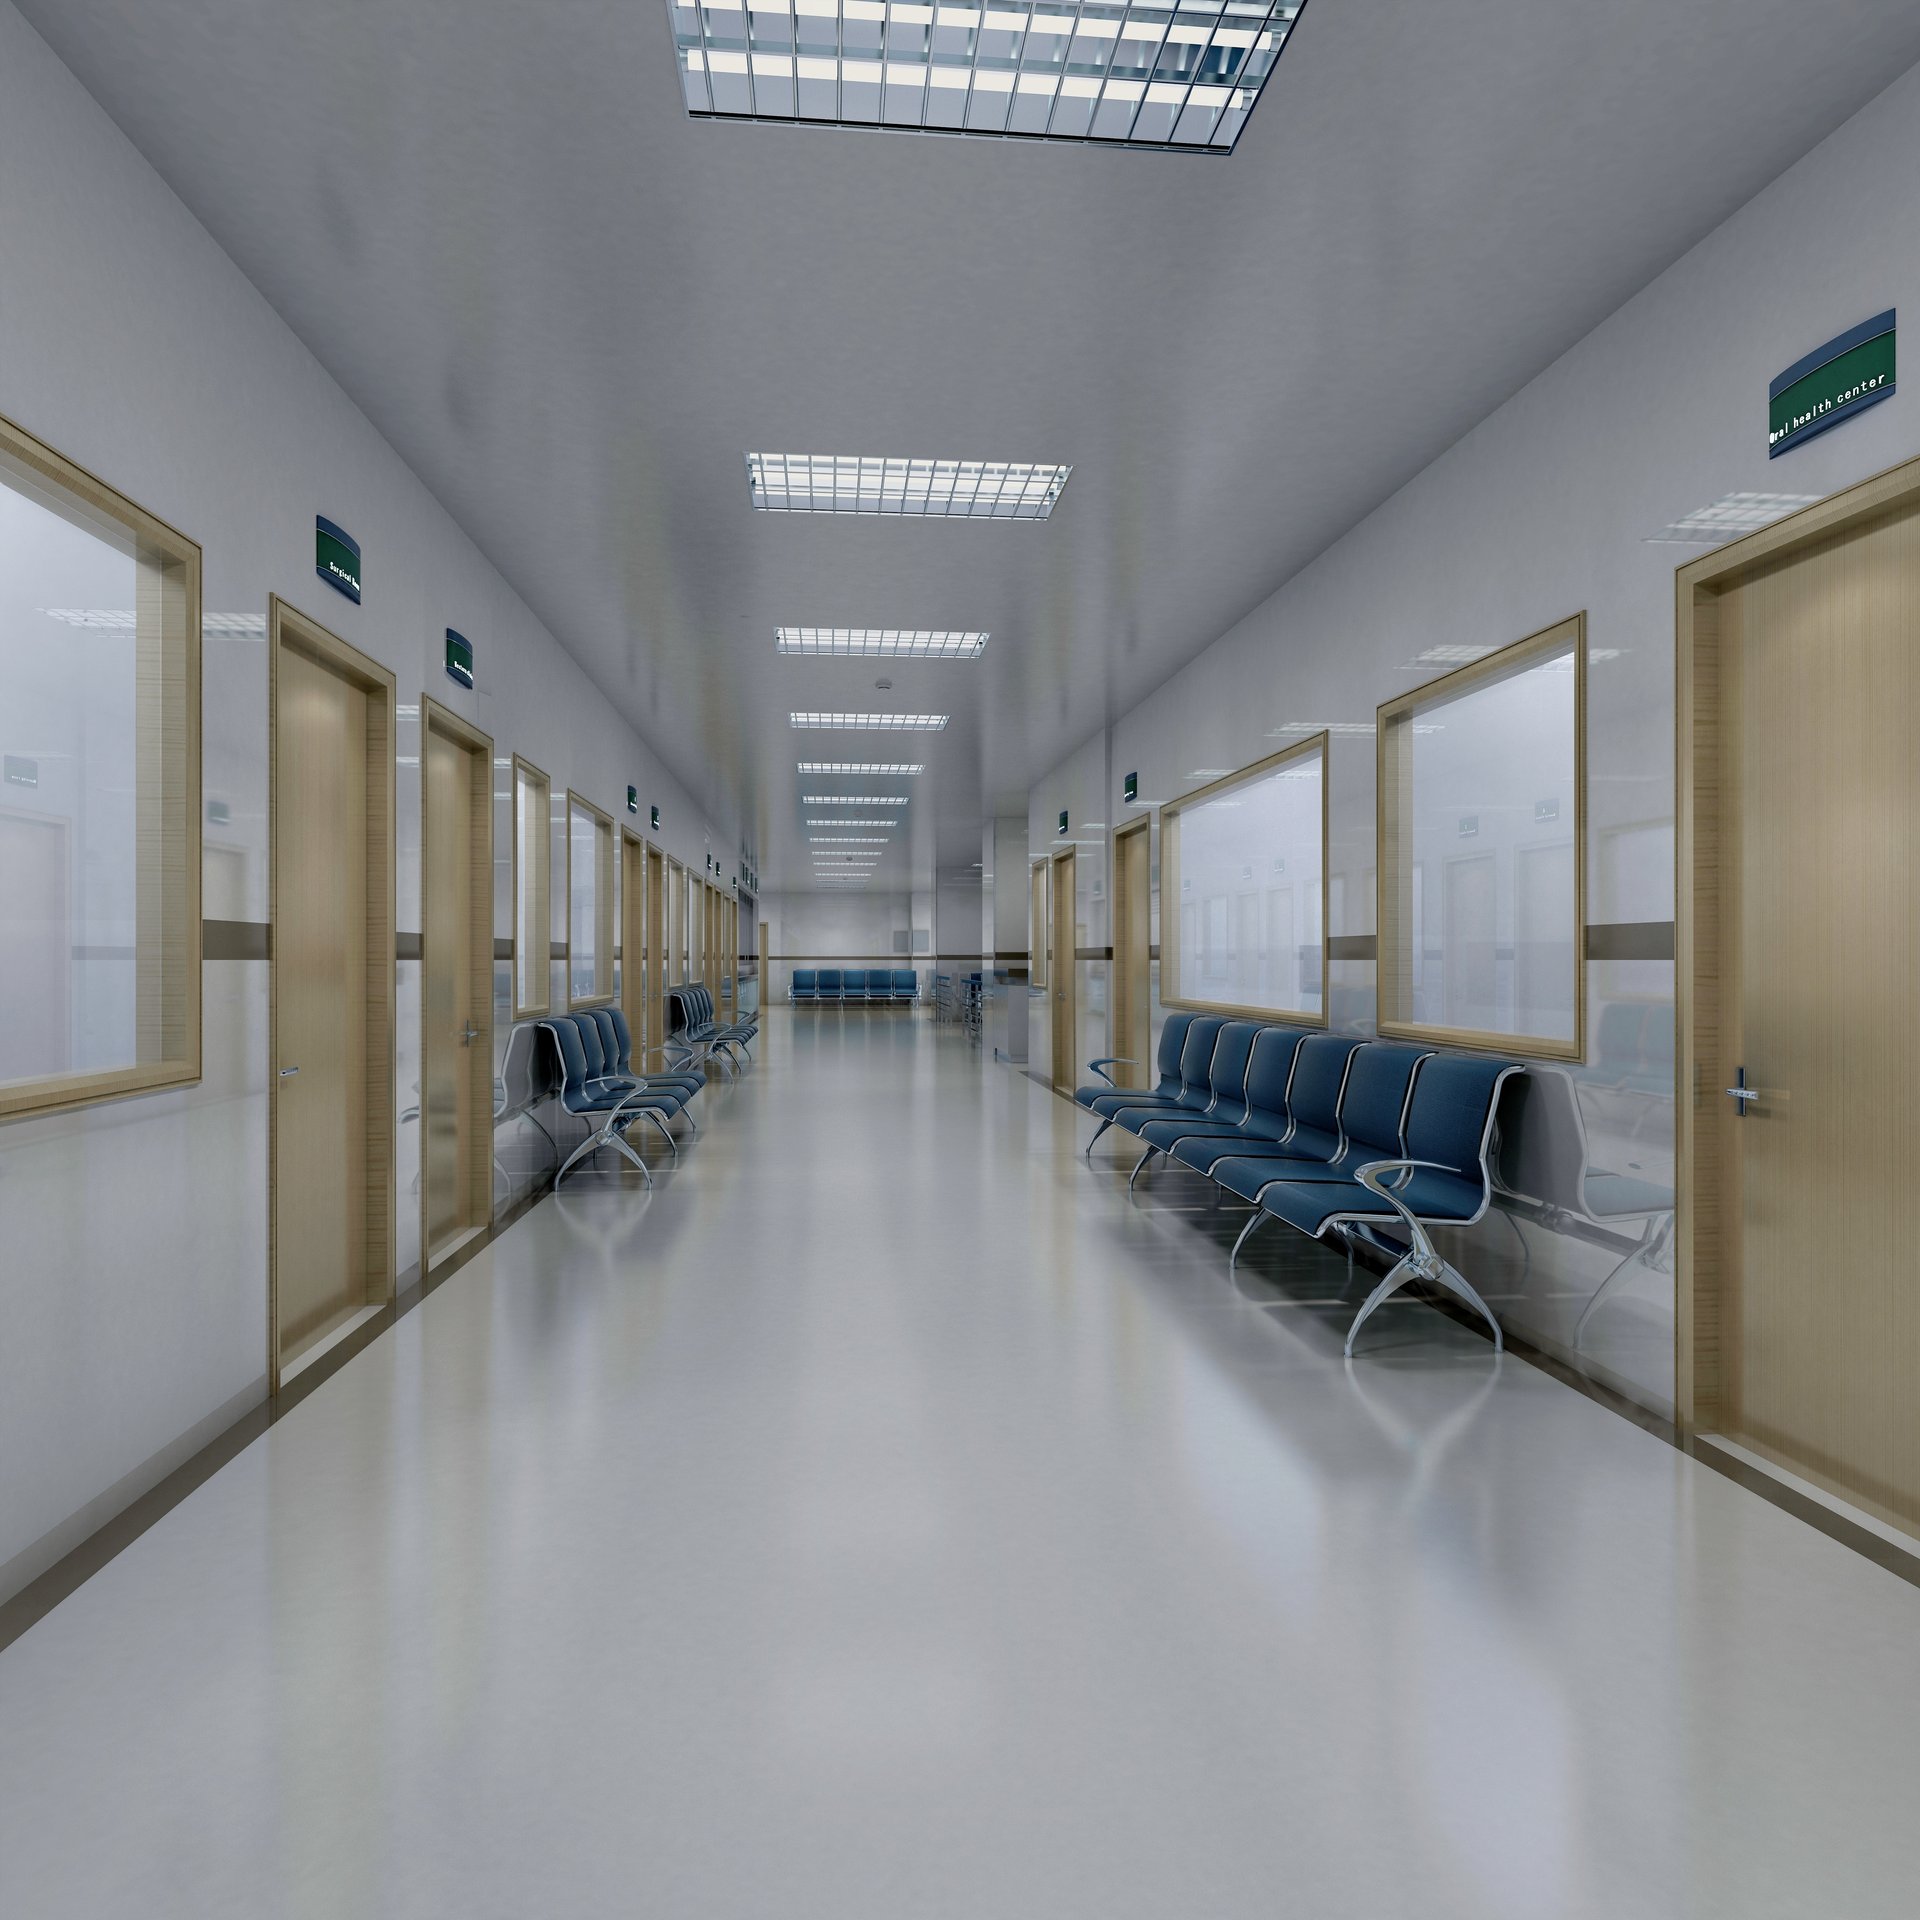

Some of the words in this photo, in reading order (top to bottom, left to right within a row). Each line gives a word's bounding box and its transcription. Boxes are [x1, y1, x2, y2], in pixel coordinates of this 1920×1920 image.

[1769, 422, 1788, 444] Oral
[1793, 399, 1831, 429] health
[1837, 374, 1885, 403] center
[329, 561, 352, 583] Surgical
